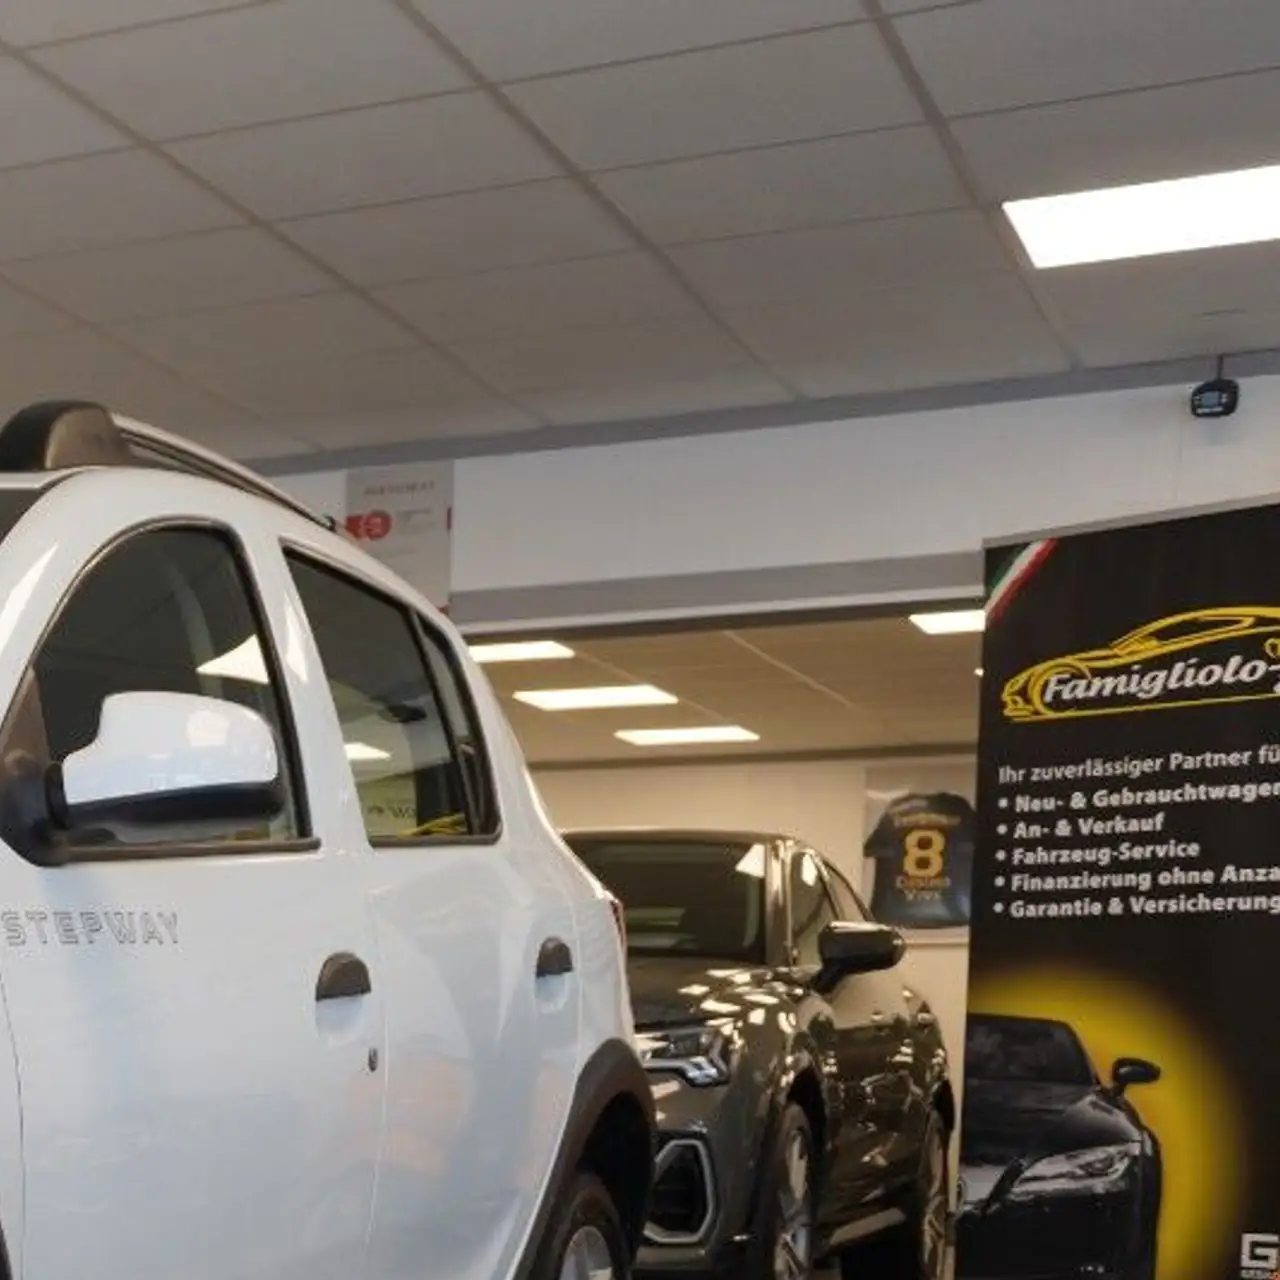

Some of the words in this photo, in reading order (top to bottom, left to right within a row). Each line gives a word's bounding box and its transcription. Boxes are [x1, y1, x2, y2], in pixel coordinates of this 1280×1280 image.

[1044, 655, 1280, 703] Famigliolo-
[999, 765, 1025, 784] Ihr
[1030, 757, 1163, 781] zuverlässiger
[1169, 750, 1252, 770] Partner
[1015, 794, 1063, 812] Neu-
[1070, 792, 1087, 809] &
[1014, 821, 1049, 838] An-
[1055, 819, 1071, 836] &
[1078, 812, 1165, 835] Verkauf
[903, 828, 946, 878] 8
[1011, 840, 1200, 866] Fahrzeug-Service
[1011, 871, 1152, 891] Finanzierung
[1157, 867, 1215, 885] ohne
[1009, 898, 1103, 917] Garantie
[1108, 897, 1124, 914] &
[1, 910, 178, 947] STEPWAY
